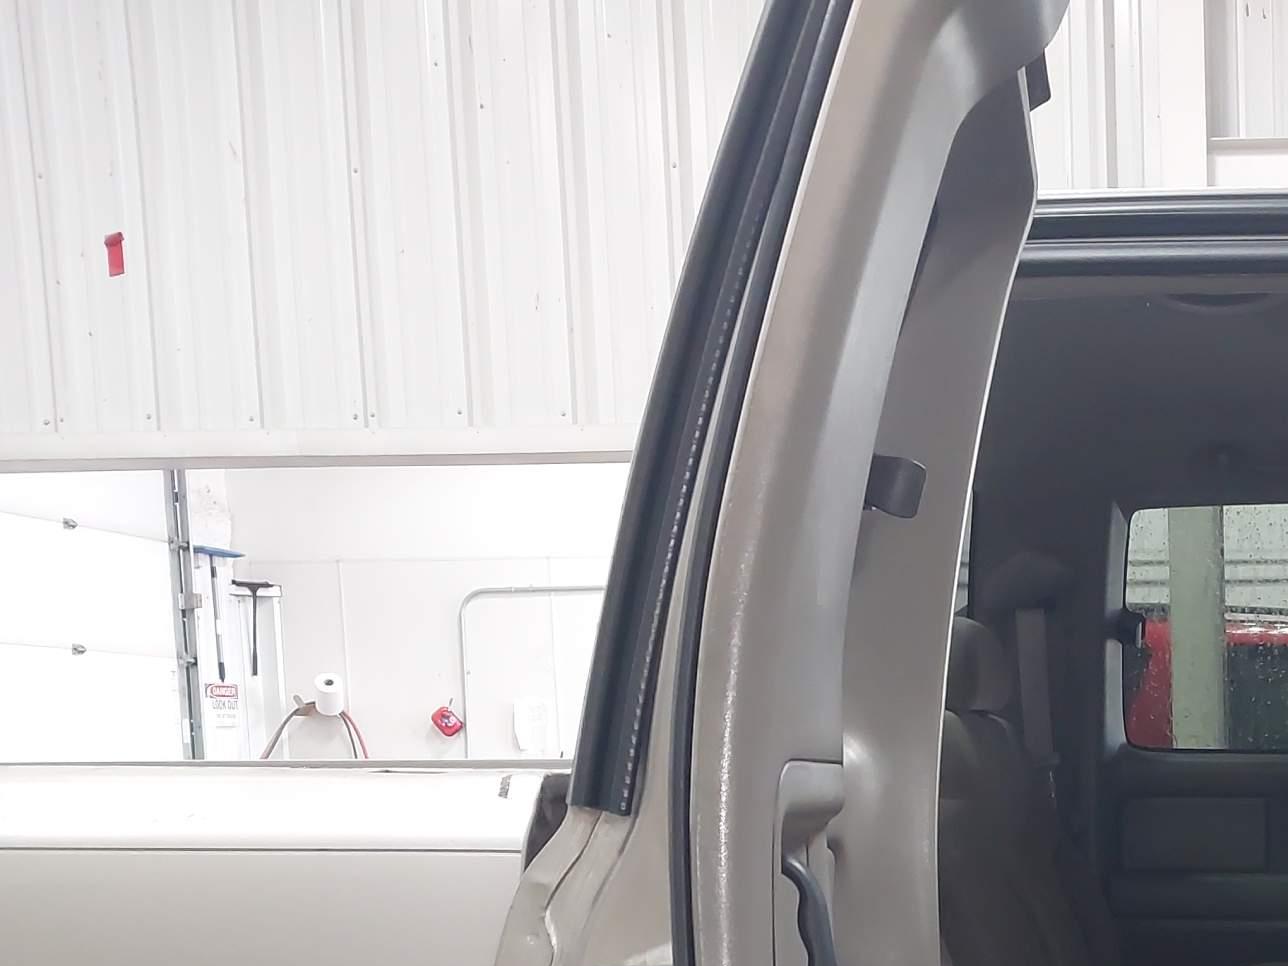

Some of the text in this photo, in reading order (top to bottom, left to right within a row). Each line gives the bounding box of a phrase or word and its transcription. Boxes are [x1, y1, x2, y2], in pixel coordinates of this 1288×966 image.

[211, 686, 236, 697] DANGER
[212, 700, 239, 710] LOCK OUT
